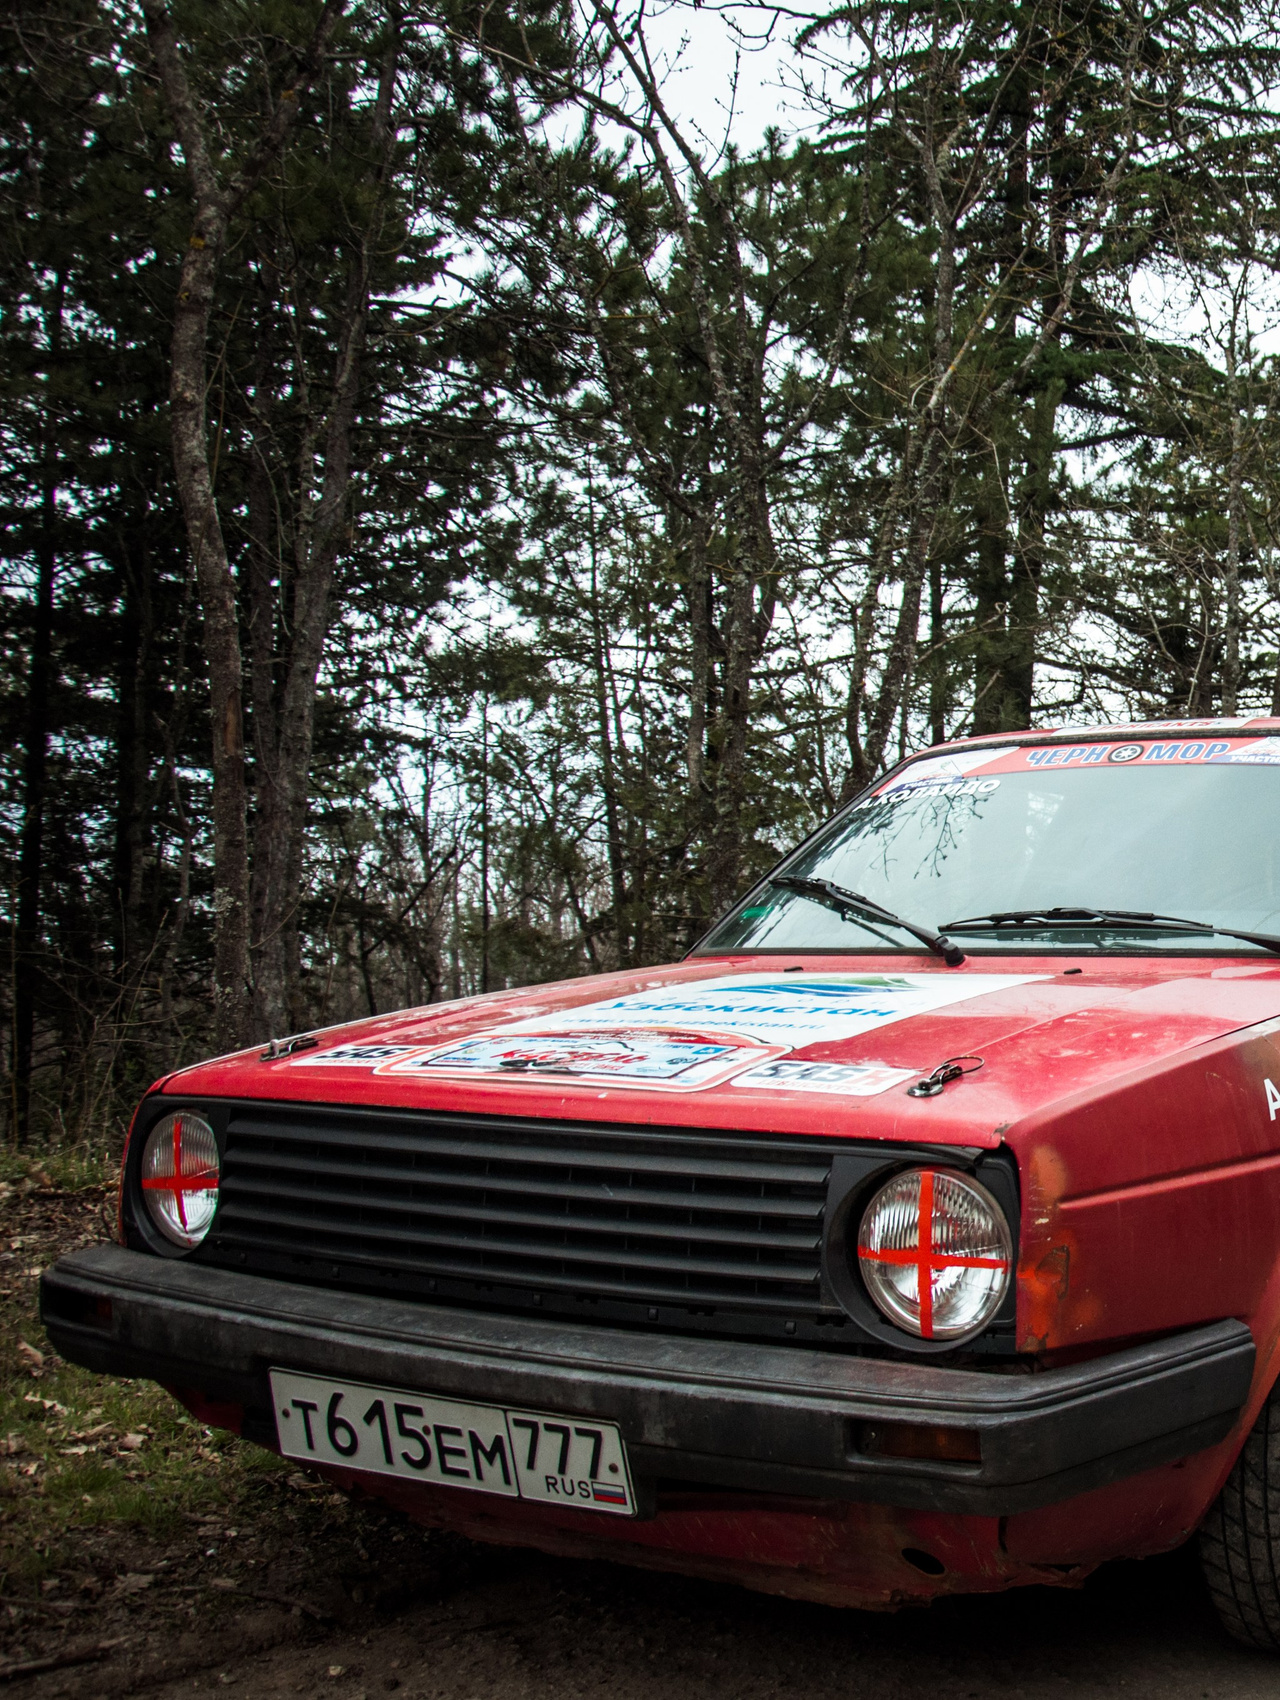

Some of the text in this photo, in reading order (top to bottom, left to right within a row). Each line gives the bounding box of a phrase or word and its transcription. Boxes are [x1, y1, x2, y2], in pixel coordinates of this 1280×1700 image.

[596, 1001, 900, 1018] Узбекистан
[747, 1062, 906, 1087] SASH
[511, 1417, 605, 1480] 777
[545, 1475, 592, 1500] RUS
